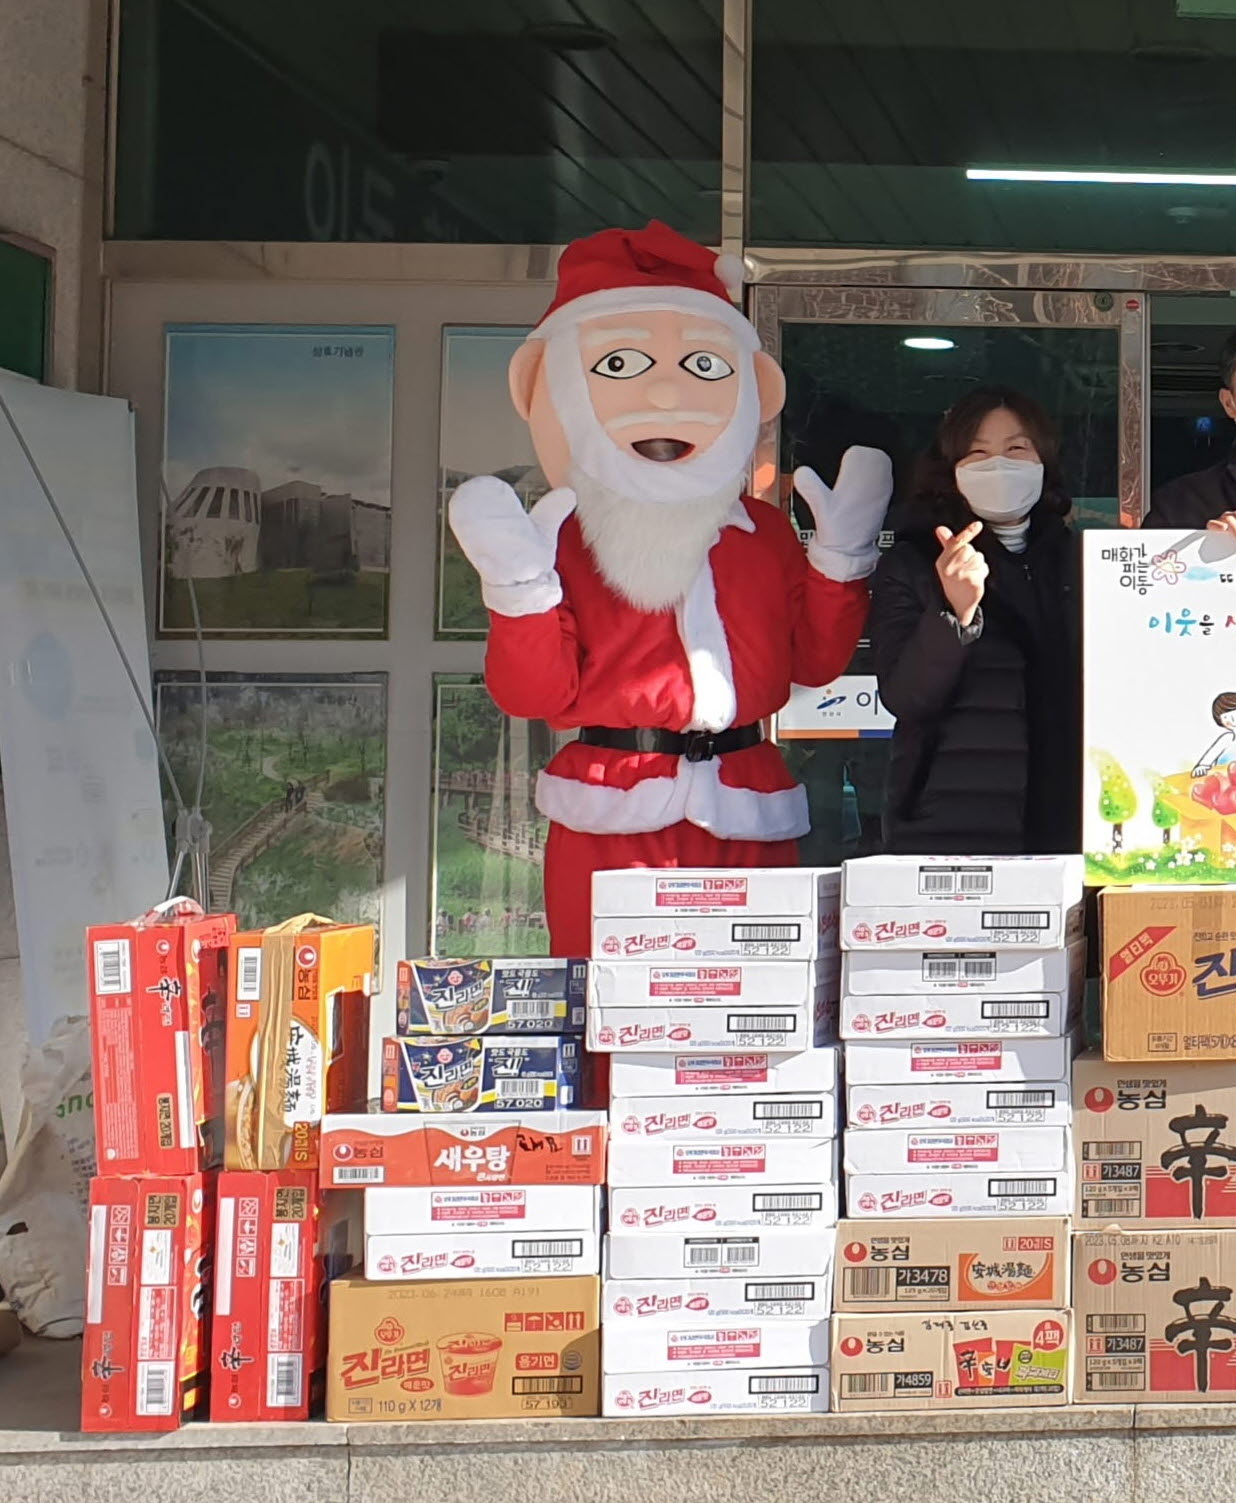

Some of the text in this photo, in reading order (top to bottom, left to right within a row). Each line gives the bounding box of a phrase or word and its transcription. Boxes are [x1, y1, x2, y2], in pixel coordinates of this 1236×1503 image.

[1102, 543, 1148, 562] 매화가
[1123, 562, 1149, 574] 피는
[1120, 576, 1153, 596] 이동
[1148, 607, 1215, 637] 이웃을
[874, 920, 921, 944] 진라면
[624, 933, 672, 957] 진라면
[146, 977, 182, 1001] 辛
[298, 969, 312, 1001] 농심
[432, 980, 484, 1011] 진라면
[874, 1011, 921, 1035] 진라면
[618, 1024, 666, 1048] 진라면
[421, 1058, 474, 1089] 진라면
[1116, 1090, 1168, 1111] 농심
[643, 1112, 691, 1136] 진라면
[878, 1101, 926, 1126] 진라면
[353, 1144, 384, 1159] 농심
[433, 1145, 511, 1173] 새우탕
[1103, 1164, 1140, 1178] 가3487
[148, 1195, 162, 1225] 봉지면
[163, 1195, 178, 1225] 20개입
[275, 1187, 290, 1218] 봉지면
[291, 1187, 306, 1218] 20개입
[880, 1189, 929, 1213] 진라면
[642, 1204, 691, 1228] 진라면
[400, 1252, 449, 1275] 진라면
[870, 1245, 910, 1262] 농심
[898, 1269, 948, 1284] 가3478
[972, 1261, 1036, 1280] 安城湯麵
[1120, 1261, 1171, 1283] 농심
[635, 1294, 683, 1319] 진라면
[866, 1338, 905, 1353] 농심
[1034, 1329, 1060, 1346] 4팩
[1106, 1337, 1144, 1351] 가3487
[92, 1355, 125, 1379] 辛
[221, 1346, 254, 1371] 辛
[340, 1347, 431, 1391] 진라면
[517, 1355, 556, 1369] 용기면
[449, 1361, 492, 1383] 진라면
[896, 1374, 932, 1386] 가4859
[402, 1379, 432, 1391] 매운맛
[379, 1401, 395, 1413] 110
[637, 1387, 686, 1412] 진라면
